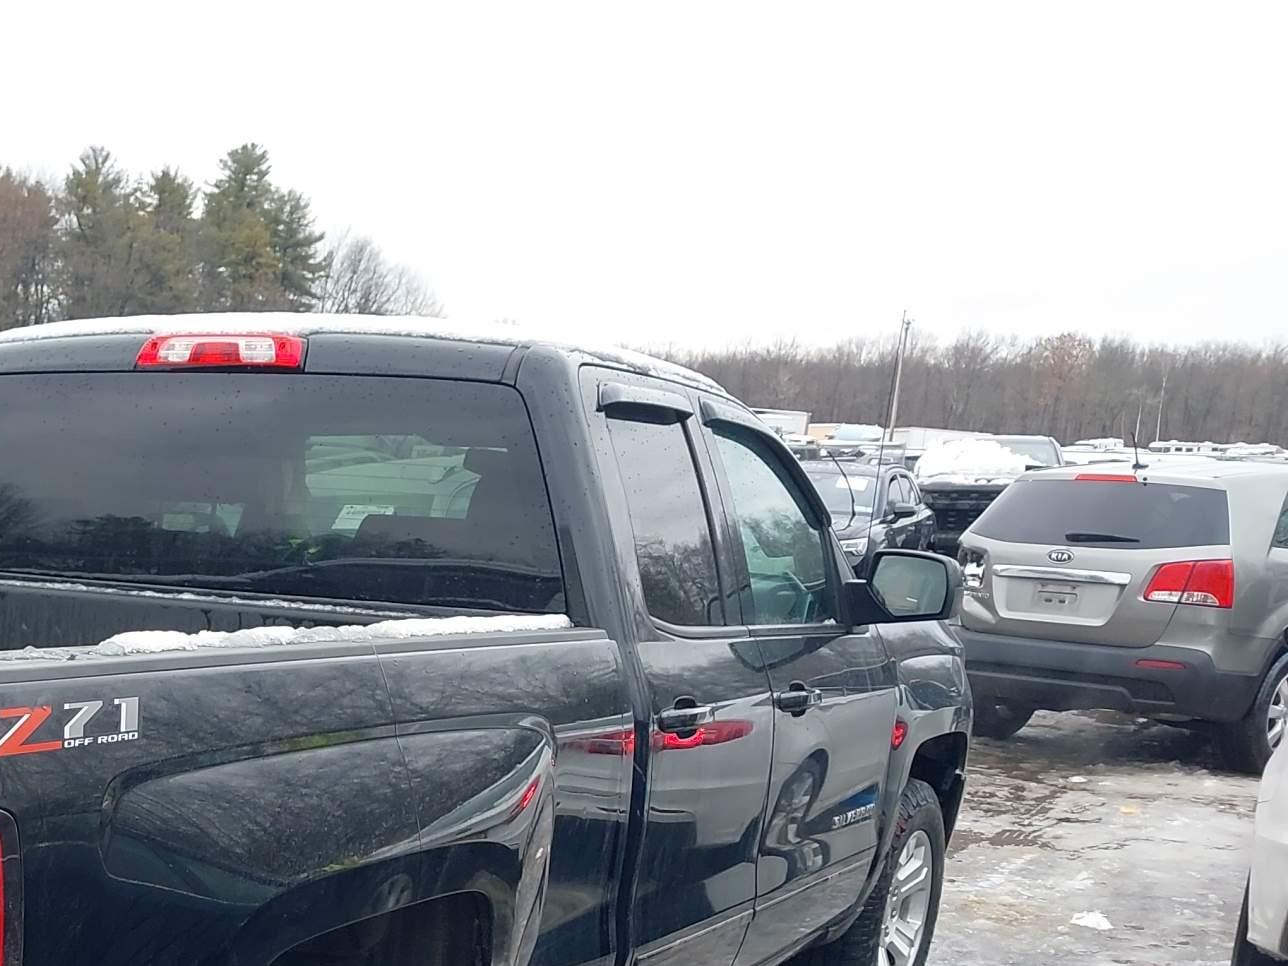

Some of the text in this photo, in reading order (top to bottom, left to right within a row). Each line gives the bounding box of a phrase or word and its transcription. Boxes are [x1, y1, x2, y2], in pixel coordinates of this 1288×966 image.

[1050, 552, 1070, 561] KIA
[63, 731, 139, 749] OFF ROAD
